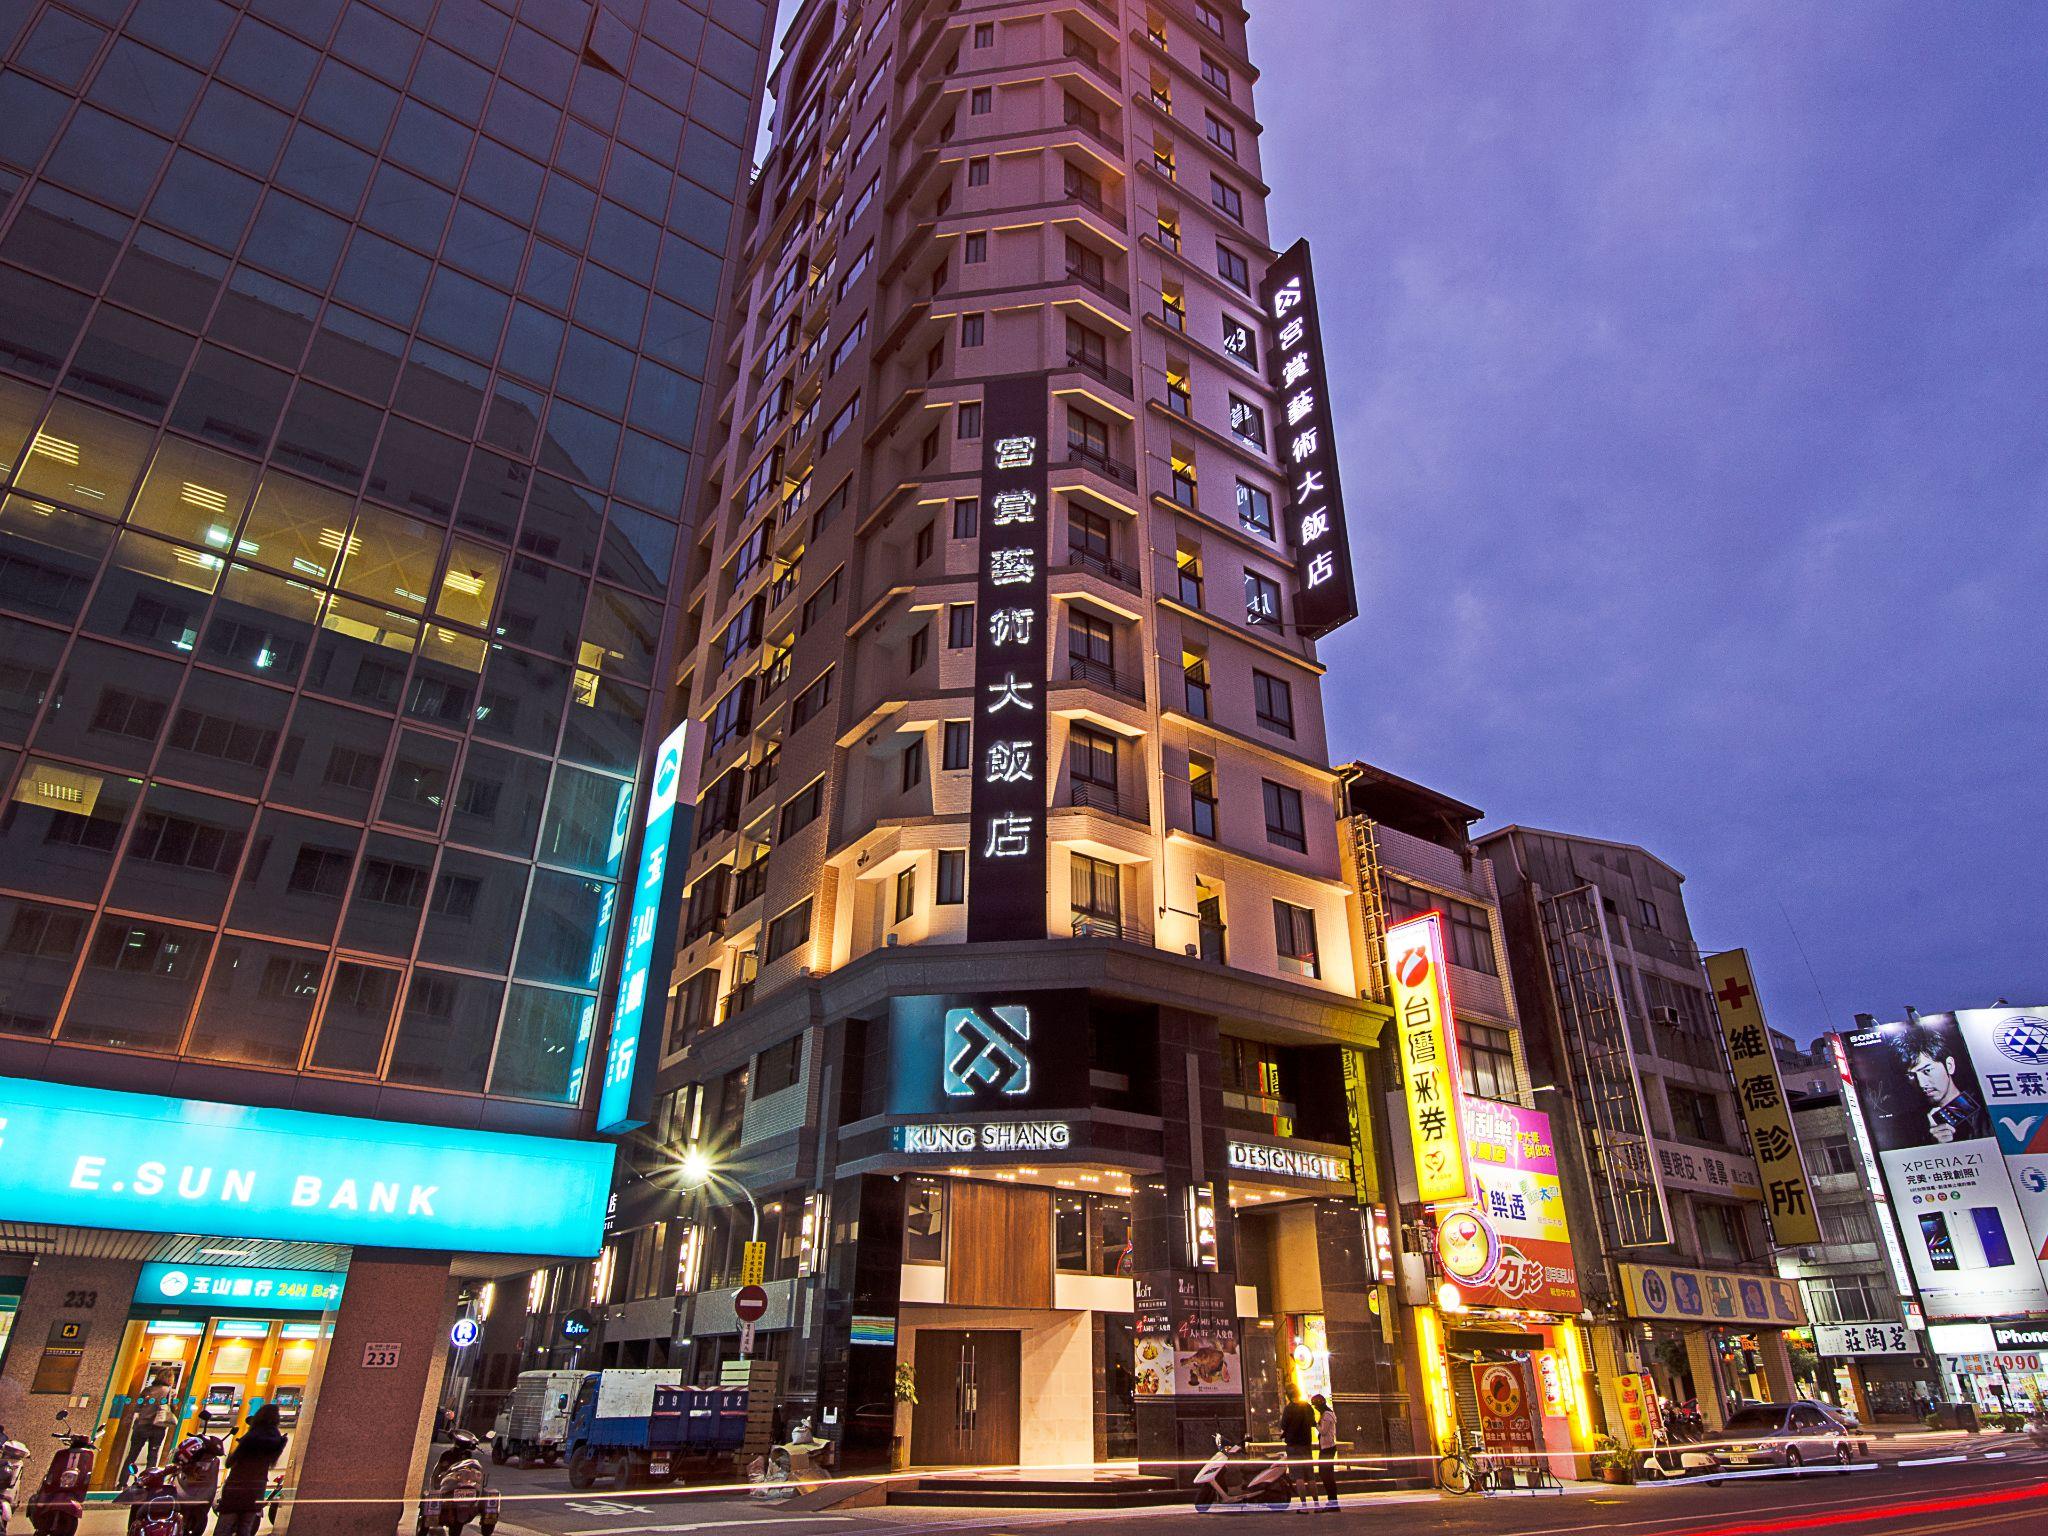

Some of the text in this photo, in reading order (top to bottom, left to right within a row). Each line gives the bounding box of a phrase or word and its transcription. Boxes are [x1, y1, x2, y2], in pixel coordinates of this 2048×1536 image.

[1278, 316, 1334, 590] 宮賞藝術大飯店
[984, 435, 1037, 858] 宮賞藝術大飯店
[1850, 1031, 1882, 1043] SONY
[1403, 995, 1447, 1142] 台灣彩券
[1986, 1072, 2048, 1098] 巨霖
[1728, 1023, 1807, 1217] 維德診所
[905, 1123, 1070, 1151] KUNG SHANG
[1234, 1145, 1349, 1180] DESIGN HOTEL
[1902, 1154, 1985, 1172] XPERIA Z1
[69, 1155, 441, 1217] E.SUN BANK
[1490, 1259, 1546, 1294] 力彩
[63, 1290, 98, 1308] 233
[366, 1352, 396, 1366] 233
[1993, 1355, 2039, 1371] 4990
